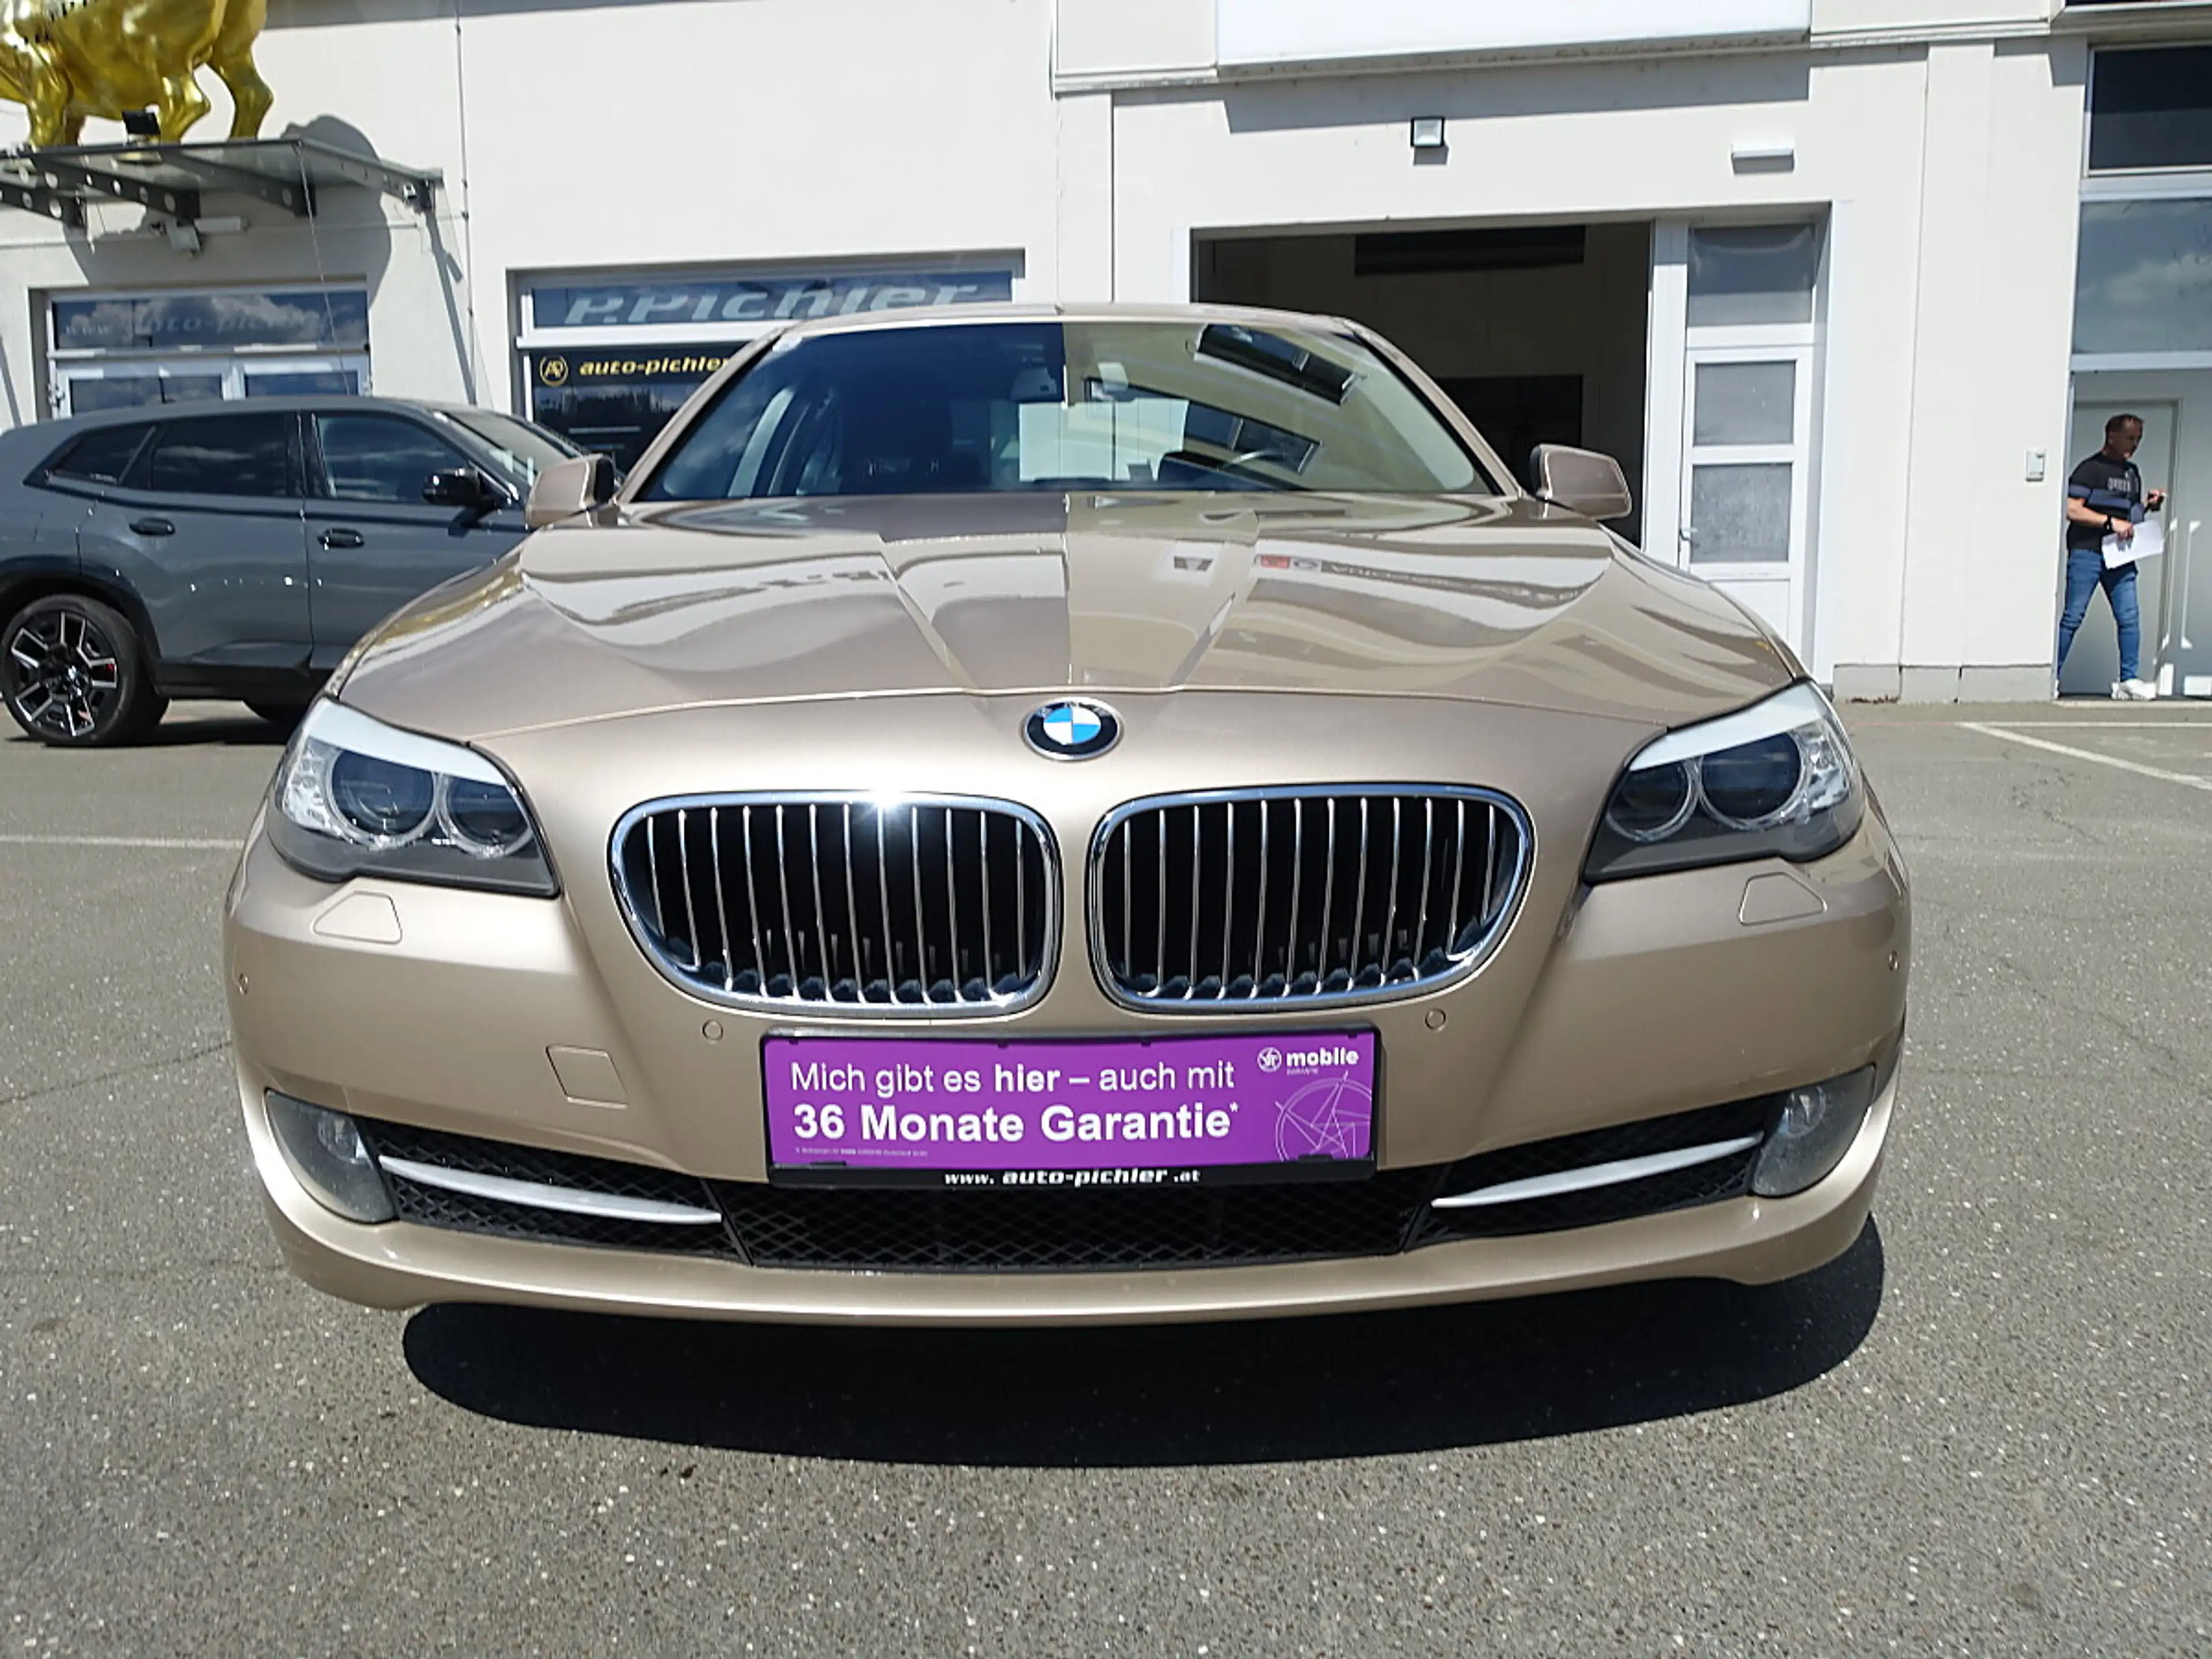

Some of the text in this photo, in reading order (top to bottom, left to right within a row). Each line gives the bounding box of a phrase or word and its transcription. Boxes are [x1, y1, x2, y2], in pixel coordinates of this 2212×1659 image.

[1286, 1046, 1359, 1067] mobile
[790, 1062, 866, 1092] Mich
[875, 1063, 934, 1098] gibt
[943, 1069, 982, 1092] es
[994, 1063, 1060, 1092] hier
[1099, 1062, 1175, 1090] auch
[1188, 1060, 1234, 1088] mit
[793, 1104, 845, 1139] 36
[861, 1104, 1024, 1142] Monate
[944, 1173, 994, 1185] www.
[1002, 1167, 1168, 1188] auto-pichler
